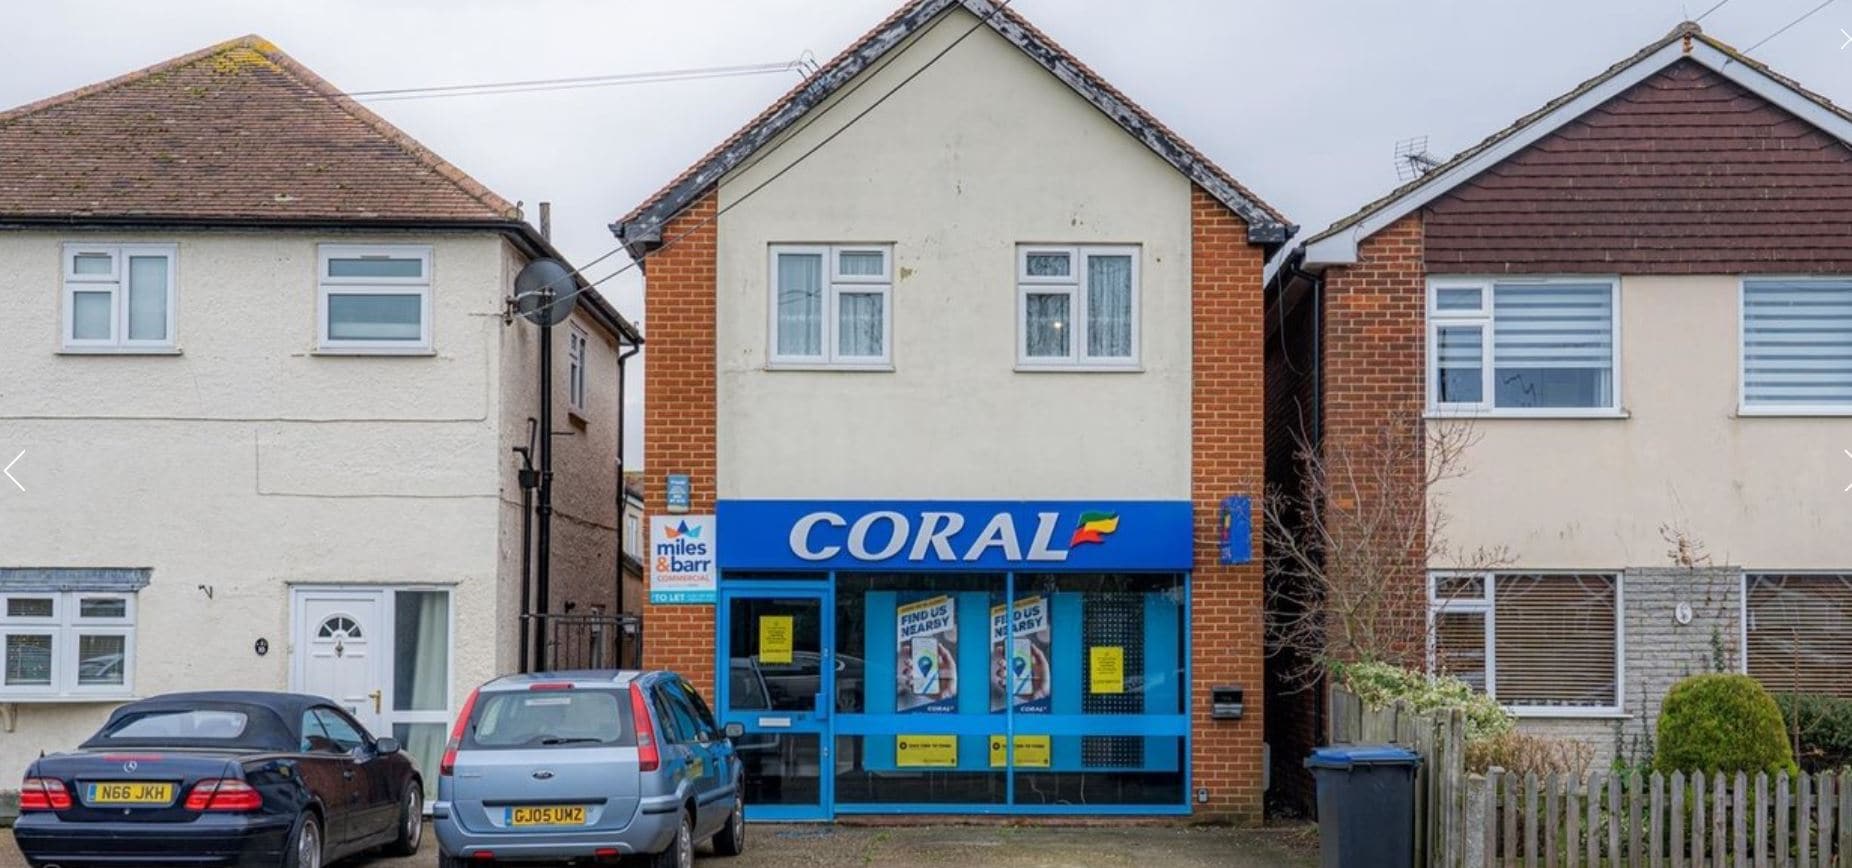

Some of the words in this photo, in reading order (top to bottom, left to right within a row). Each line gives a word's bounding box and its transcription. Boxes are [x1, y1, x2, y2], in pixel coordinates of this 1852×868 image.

[788, 510, 1070, 562] CORAL
[657, 538, 706, 555] miles
[656, 556, 711, 573] &barr
[657, 574, 710, 583] COMMERCIAL
[655, 593, 668, 602] TO
[669, 593, 686, 602] LET
[901, 610, 929, 626] FIND
[930, 605, 948, 618] US
[1023, 605, 1041, 618] US
[901, 615, 949, 637] NEARBY
[101, 785, 131, 800] N66
[135, 785, 165, 800] JKH
[514, 808, 552, 822] GJ05
[554, 807, 583, 821] UMZ
